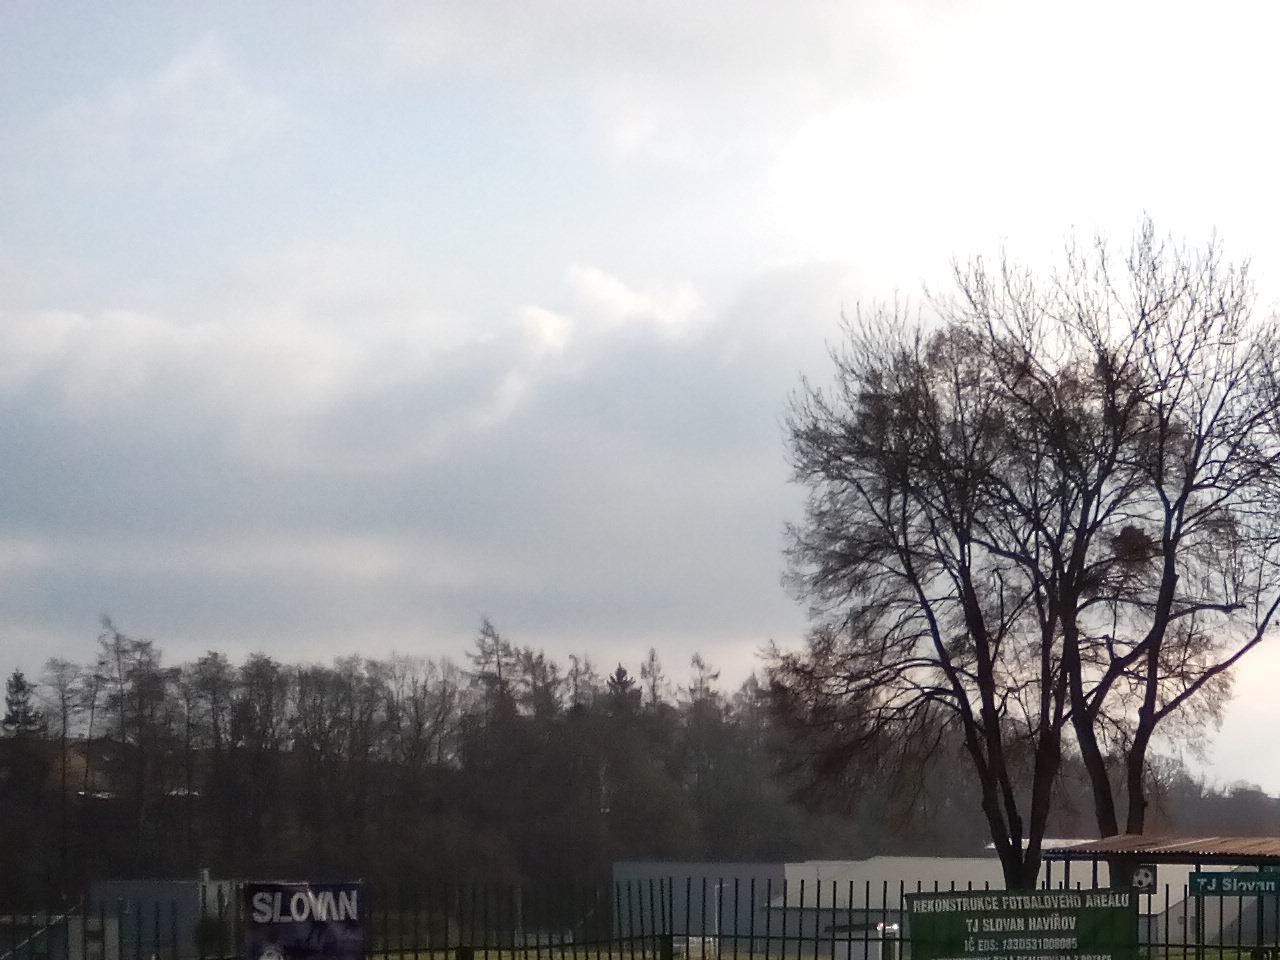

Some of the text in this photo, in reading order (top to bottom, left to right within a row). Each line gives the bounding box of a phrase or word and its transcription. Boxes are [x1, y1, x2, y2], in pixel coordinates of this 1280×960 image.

[1222, 877, 1276, 891] Slovan
[252, 890, 358, 923] SLOVAN
[913, 896, 999, 913] REKONSTRUKCE
[1086, 890, 1129, 907] AREÁLU
[966, 913, 1076, 932] TJ SLOVAN HAVÍŘOV
